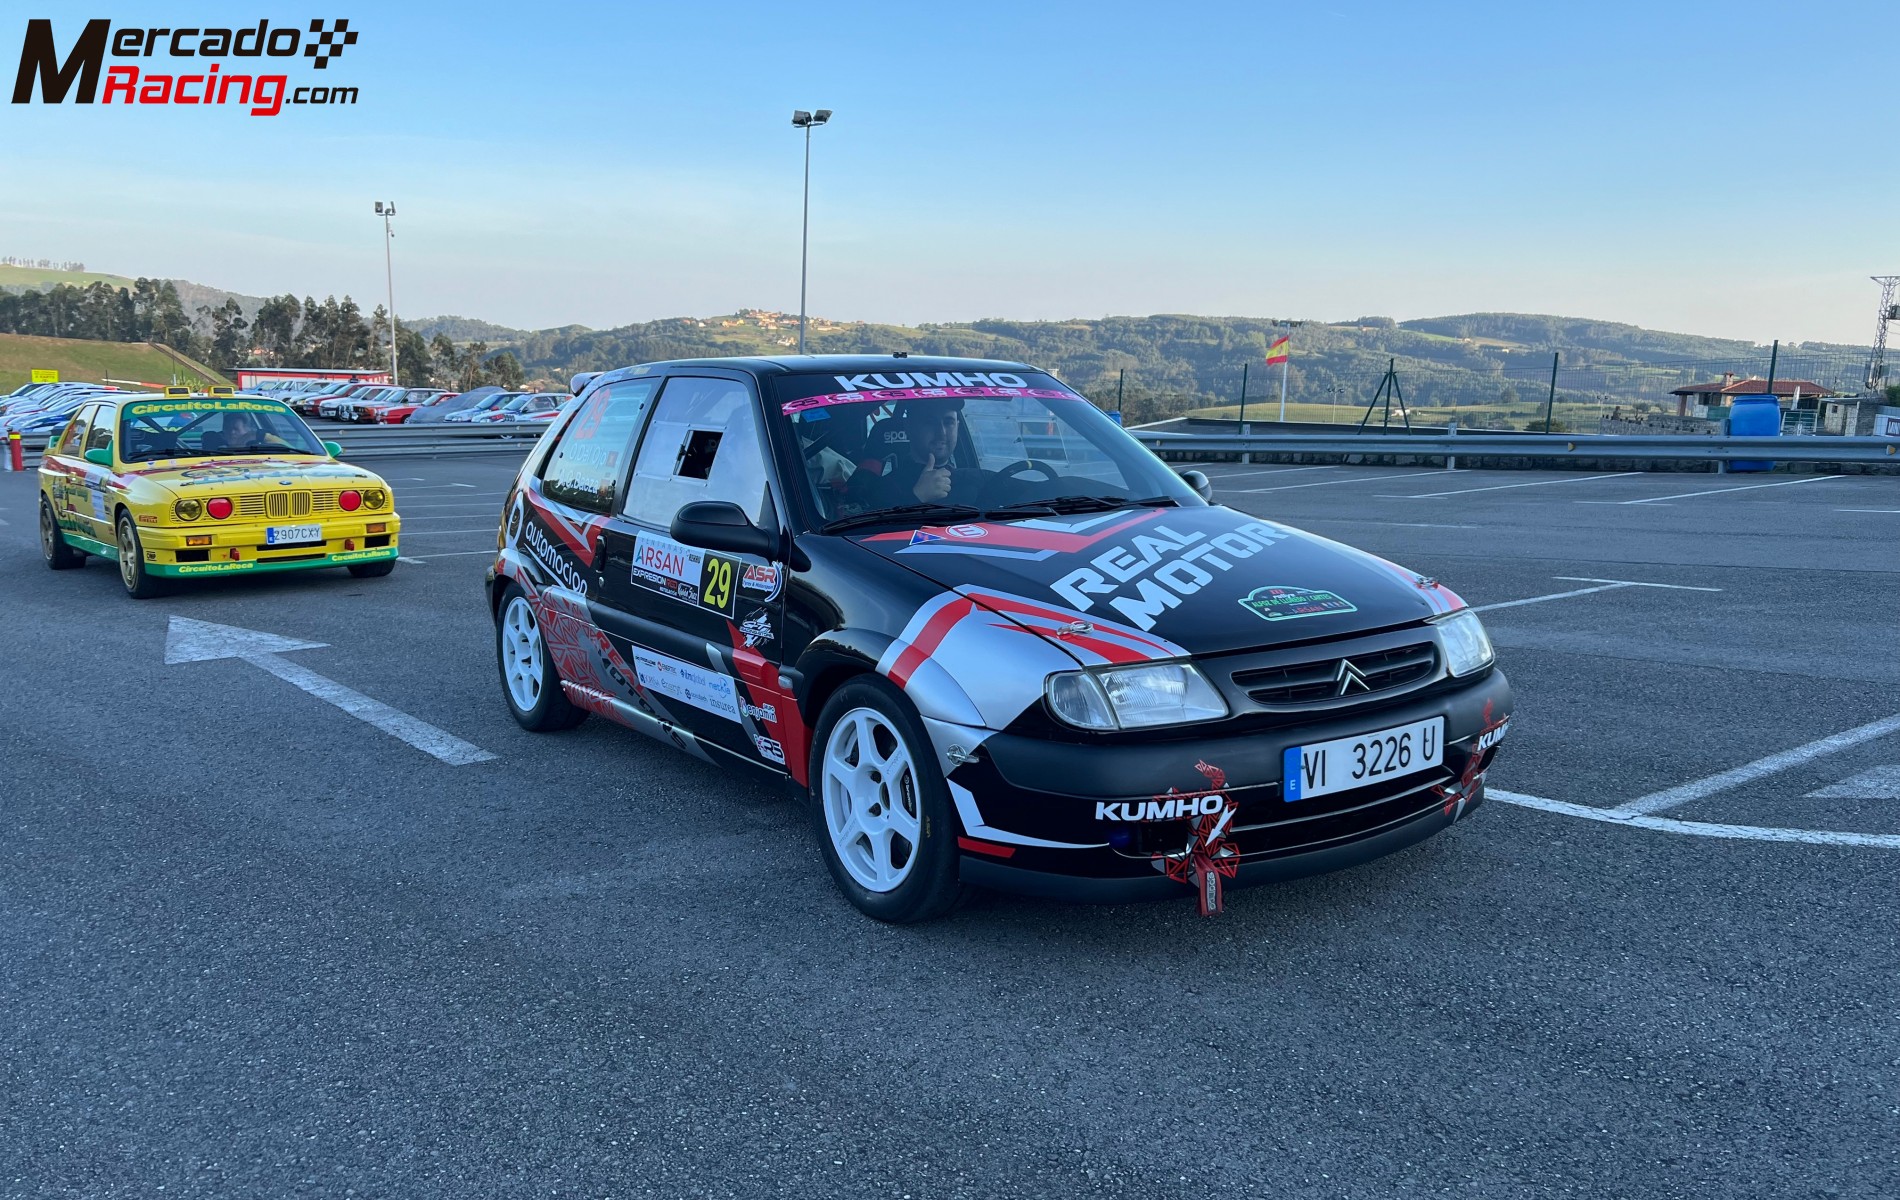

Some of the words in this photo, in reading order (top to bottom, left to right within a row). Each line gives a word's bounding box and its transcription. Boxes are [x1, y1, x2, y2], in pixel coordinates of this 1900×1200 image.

[834, 372, 1028, 390] KUMHO
[131, 402, 286, 415] CircuitoLaRoca
[883, 431, 909, 445] spa
[179, 563, 254, 573] CircuitoLaRoca
[525, 521, 588, 597] automocion
[635, 545, 685, 577] ARSAN
[1050, 525, 1208, 612] REAL
[704, 558, 732, 609] 29
[743, 565, 776, 583] ASR
[1303, 749, 1326, 789] VI
[1352, 733, 1411, 779] 3226
[1423, 725, 1436, 761] U
[1290, 779, 1296, 791] E
[1095, 794, 1224, 821] KUMHO
